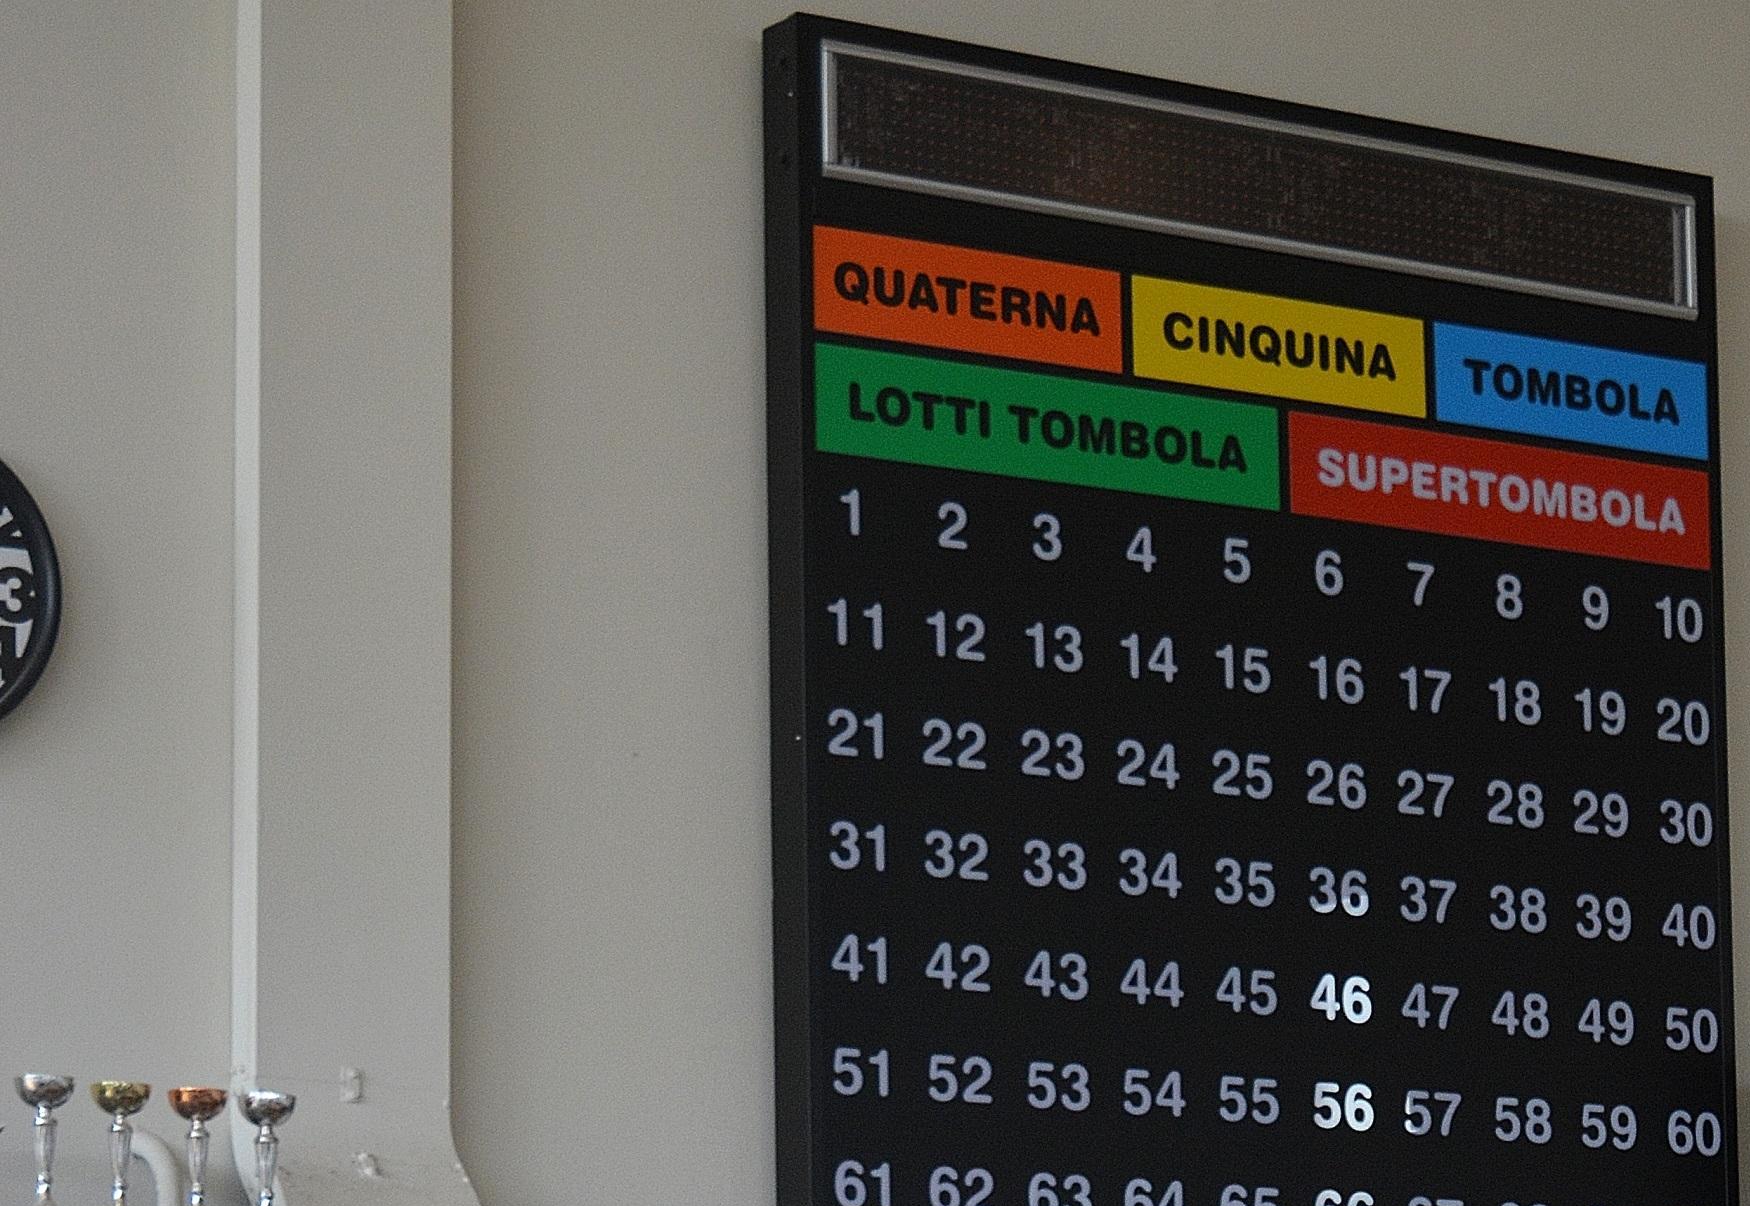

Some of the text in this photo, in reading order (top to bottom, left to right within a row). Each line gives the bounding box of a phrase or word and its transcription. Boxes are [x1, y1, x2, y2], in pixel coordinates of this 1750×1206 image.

[833, 262, 1101, 337] QUATERNA
[1163, 312, 1397, 382] CINQUINA
[848, 381, 1248, 474] LOTTI TOMBOLA
[1463, 357, 1680, 426] TOMBOLA
[1316, 447, 1687, 536] SUPERTOMBOLA
[840, 489, 1703, 643] 1 2 3 4 5 6 7 8 9 10
[827, 598, 1710, 745] 11 12 13 14 15 16 17 18 19 20
[828, 708, 1713, 847] 21 22 23 24 25 26 27 28 29 30
[829, 820, 1716, 950] 31 32 33 34 35 36 37 38 39 40
[831, 934, 1719, 1053] 41 42 43 44 45 46 47 48 49 50
[833, 1047, 1721, 1157] 51 52 53 54 55 56 57 58 59 60
